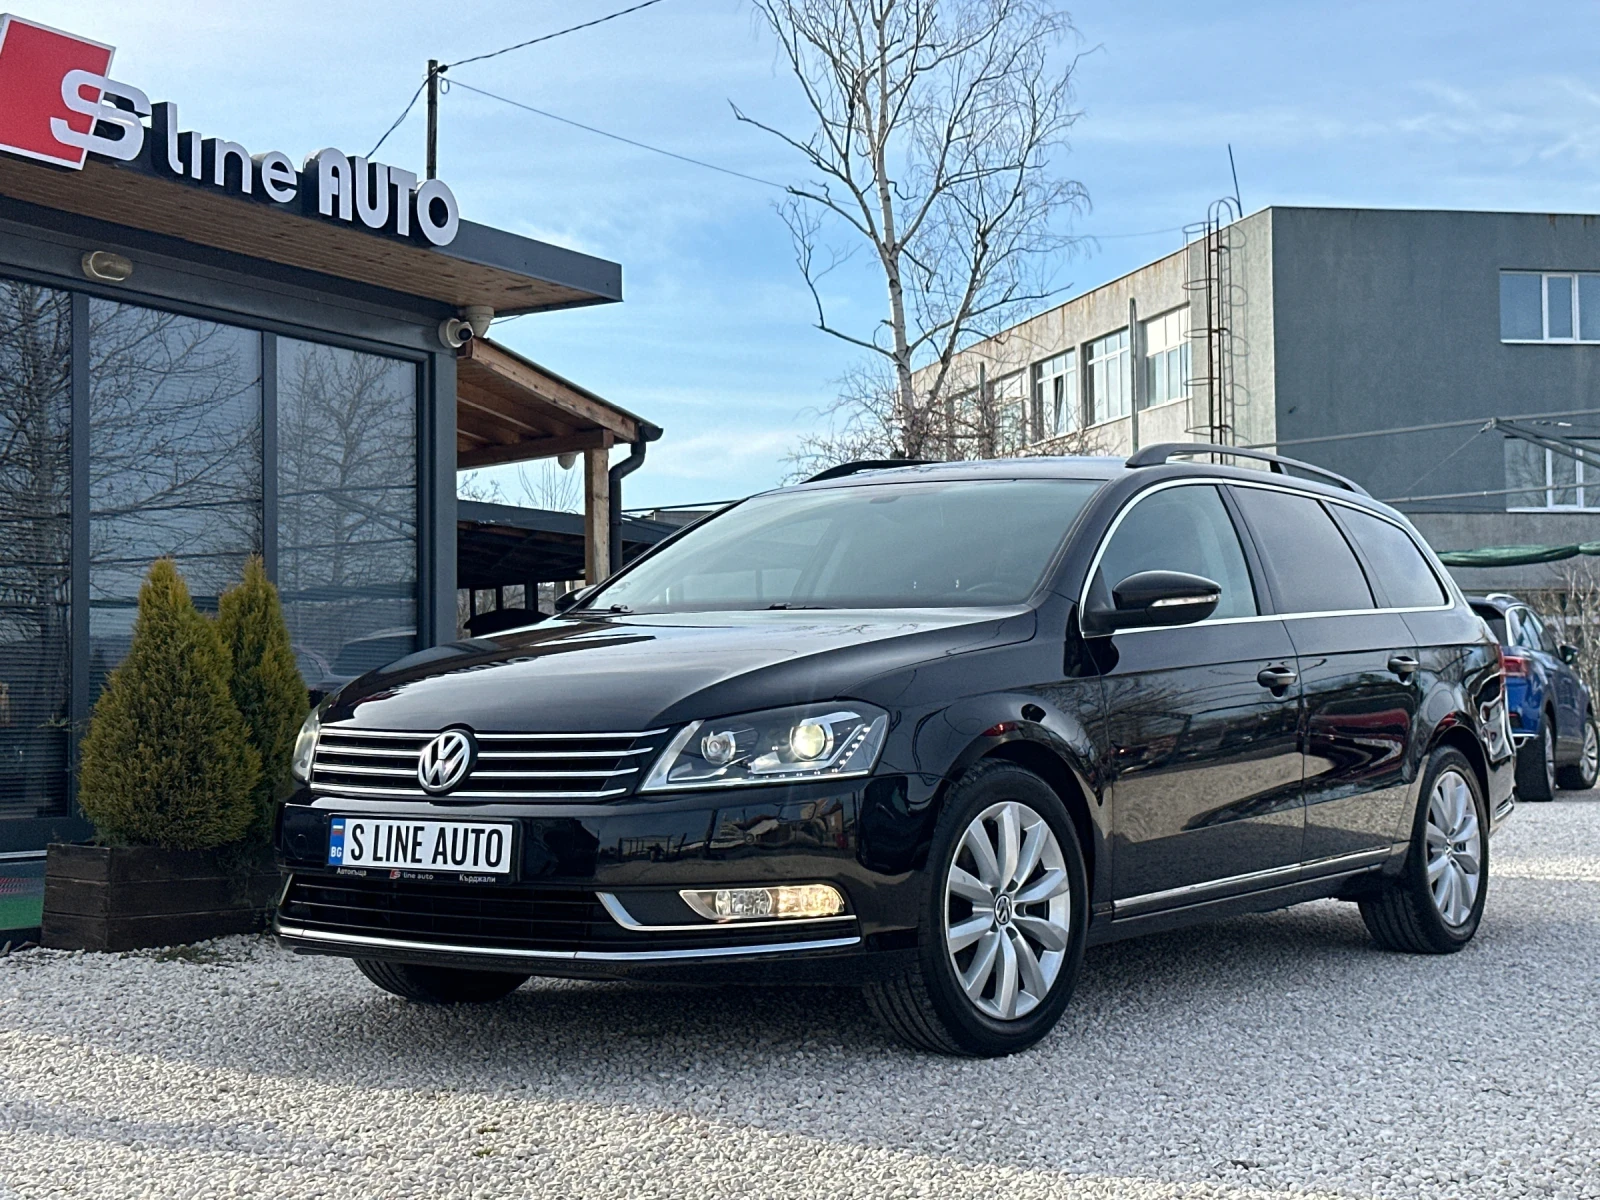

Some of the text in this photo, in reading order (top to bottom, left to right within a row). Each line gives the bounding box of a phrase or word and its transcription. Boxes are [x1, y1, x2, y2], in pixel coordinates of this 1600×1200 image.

[50, 69, 150, 162] S
[317, 147, 460, 247] AUTO
[350, 823, 504, 868] S LINE AUTO
[330, 846, 343, 858] BG
[403, 871, 416, 880] line
[417, 872, 434, 880] auto
[459, 873, 496, 884] Кърджали
